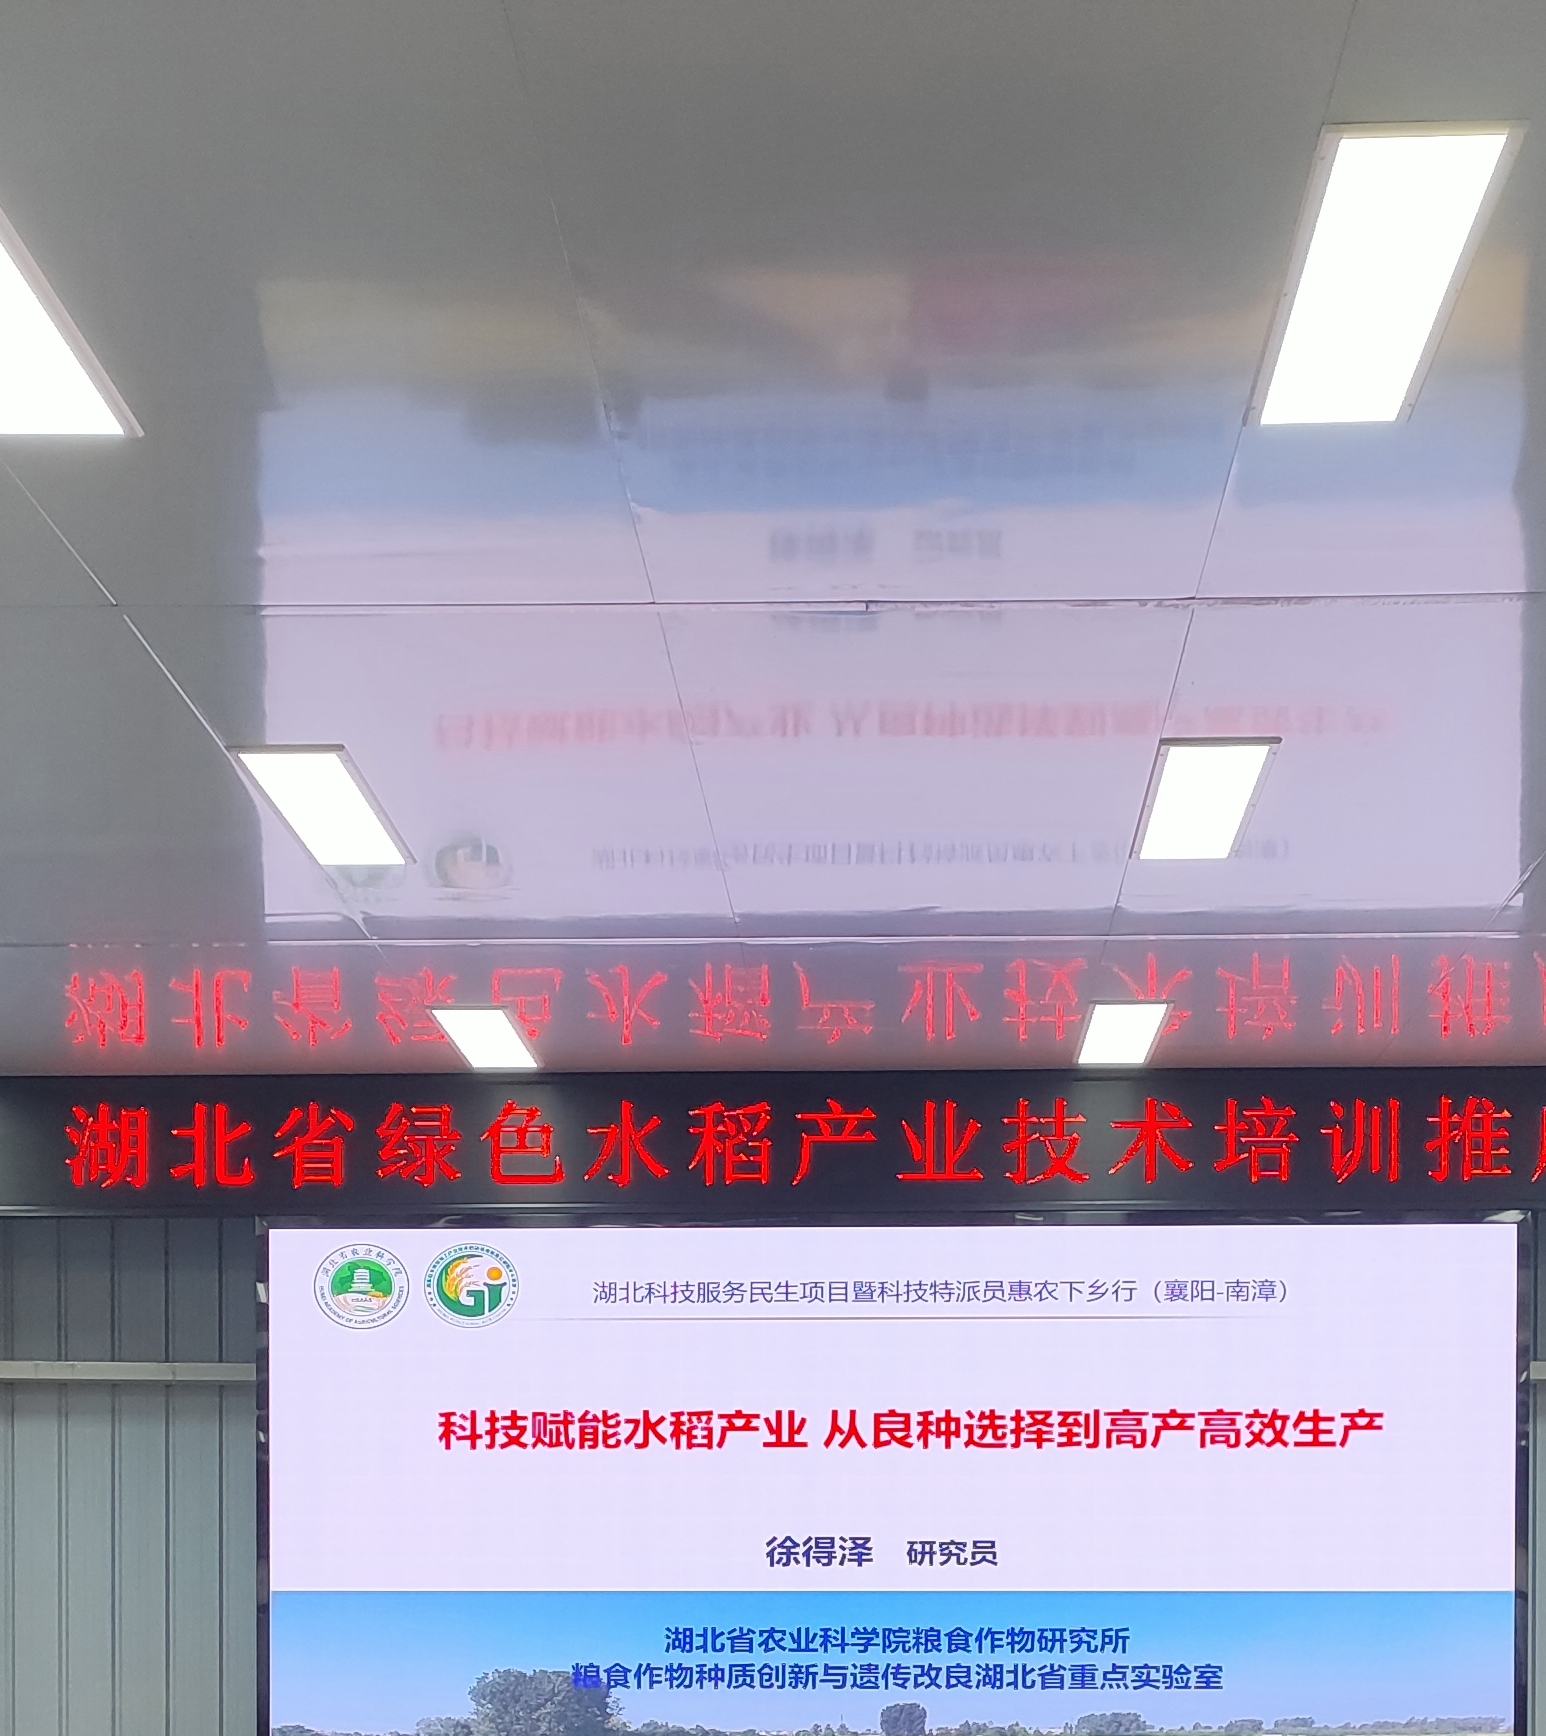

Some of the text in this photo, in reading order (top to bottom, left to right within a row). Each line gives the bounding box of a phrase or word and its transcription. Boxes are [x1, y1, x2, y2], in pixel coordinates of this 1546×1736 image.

[592, 1278, 1291, 1304] 湖北科技服务民生项目暨科技特派员惠农下乡行（襄阳-南漳）
[437, 1408, 1386, 1451] 科技赋能水稻产业 从良种选择到高产高效生产
[764, 1535, 999, 1568] 徐得泽 研究员
[664, 1625, 1130, 1655] 湖北省农业科学院粮食作物研究所
[570, 1662, 1224, 1692] 粮食作物种质创新与遗传改良湖北省重点实验室
